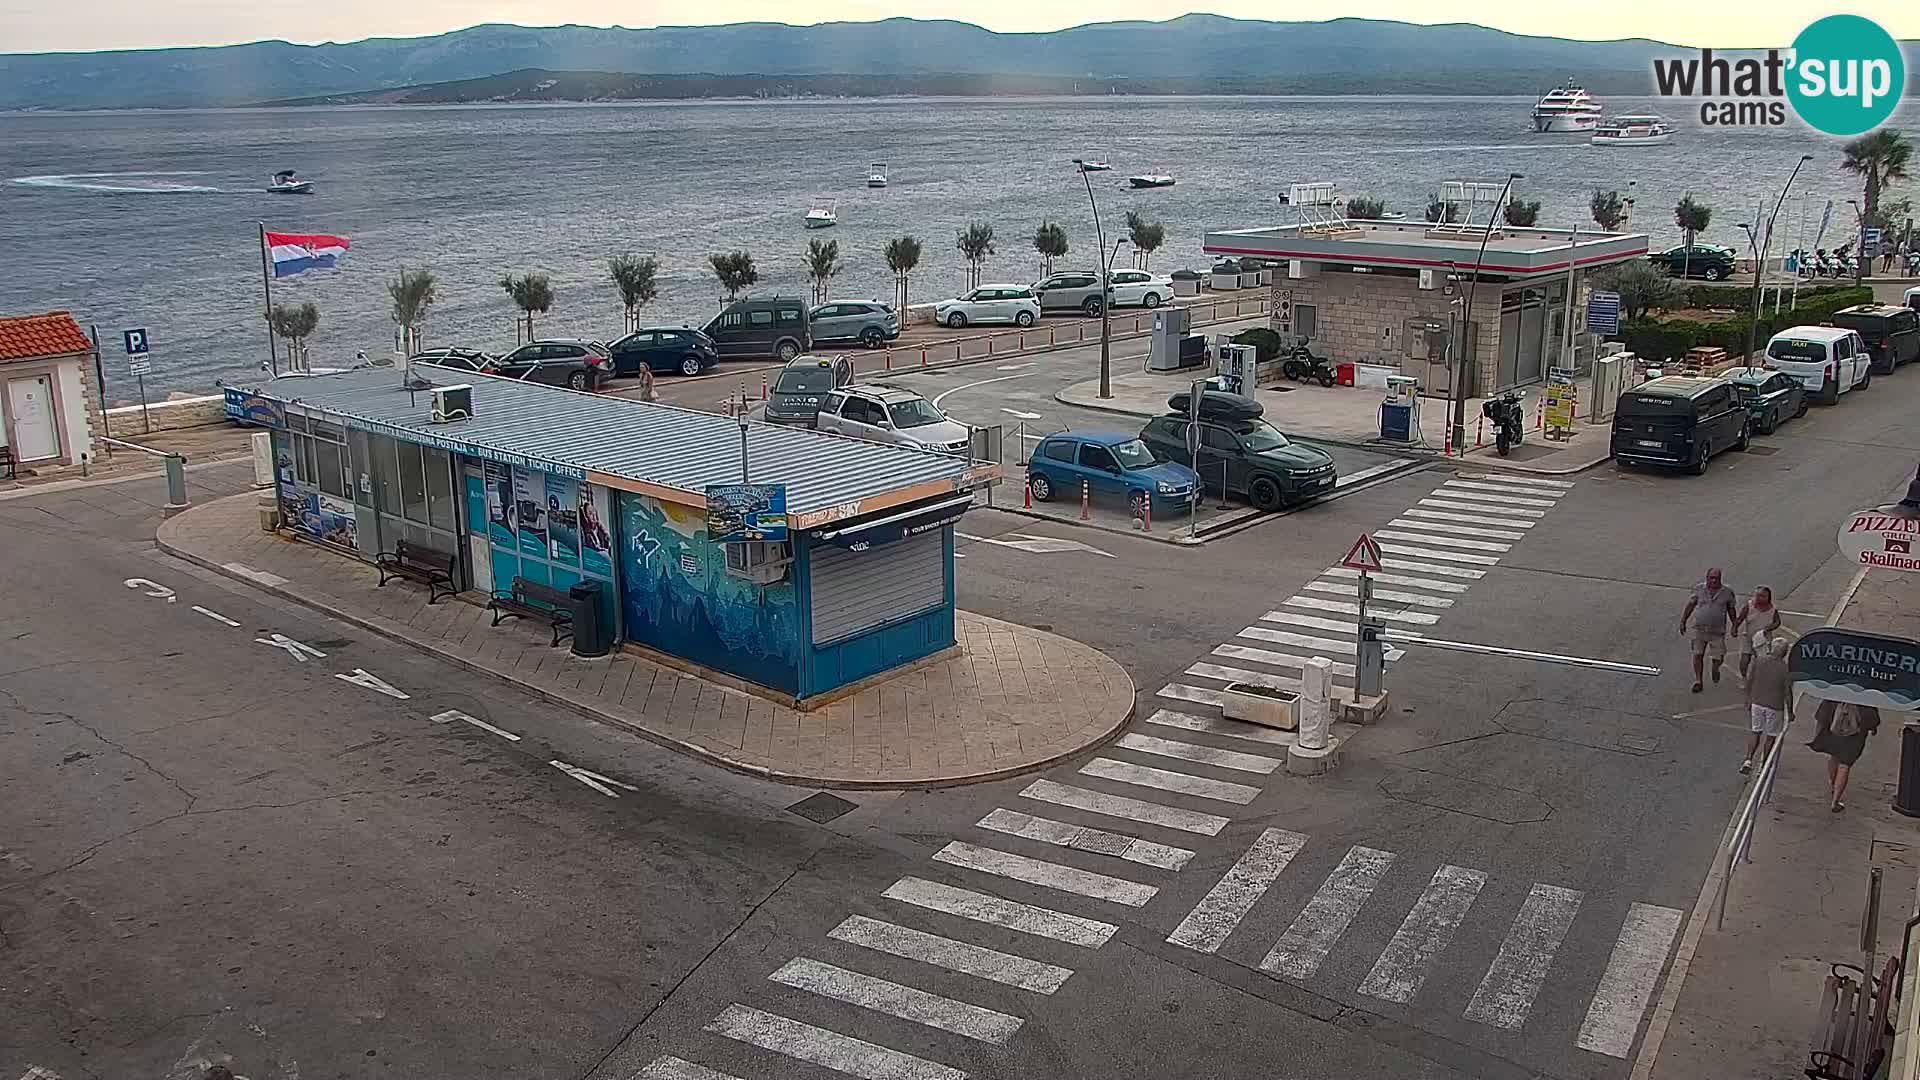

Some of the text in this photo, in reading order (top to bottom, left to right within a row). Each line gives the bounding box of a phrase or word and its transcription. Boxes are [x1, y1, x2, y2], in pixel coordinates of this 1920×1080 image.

[129, 332, 142, 351] P
[1791, 340, 1808, 348] TAXI
[436, 437, 468, 453] POSTAJA
[478, 446, 582, 478] BUS STATION TICKET OFFICE
[1881, 531, 1917, 542] GRILL
[1871, 667, 1897, 681] bar
